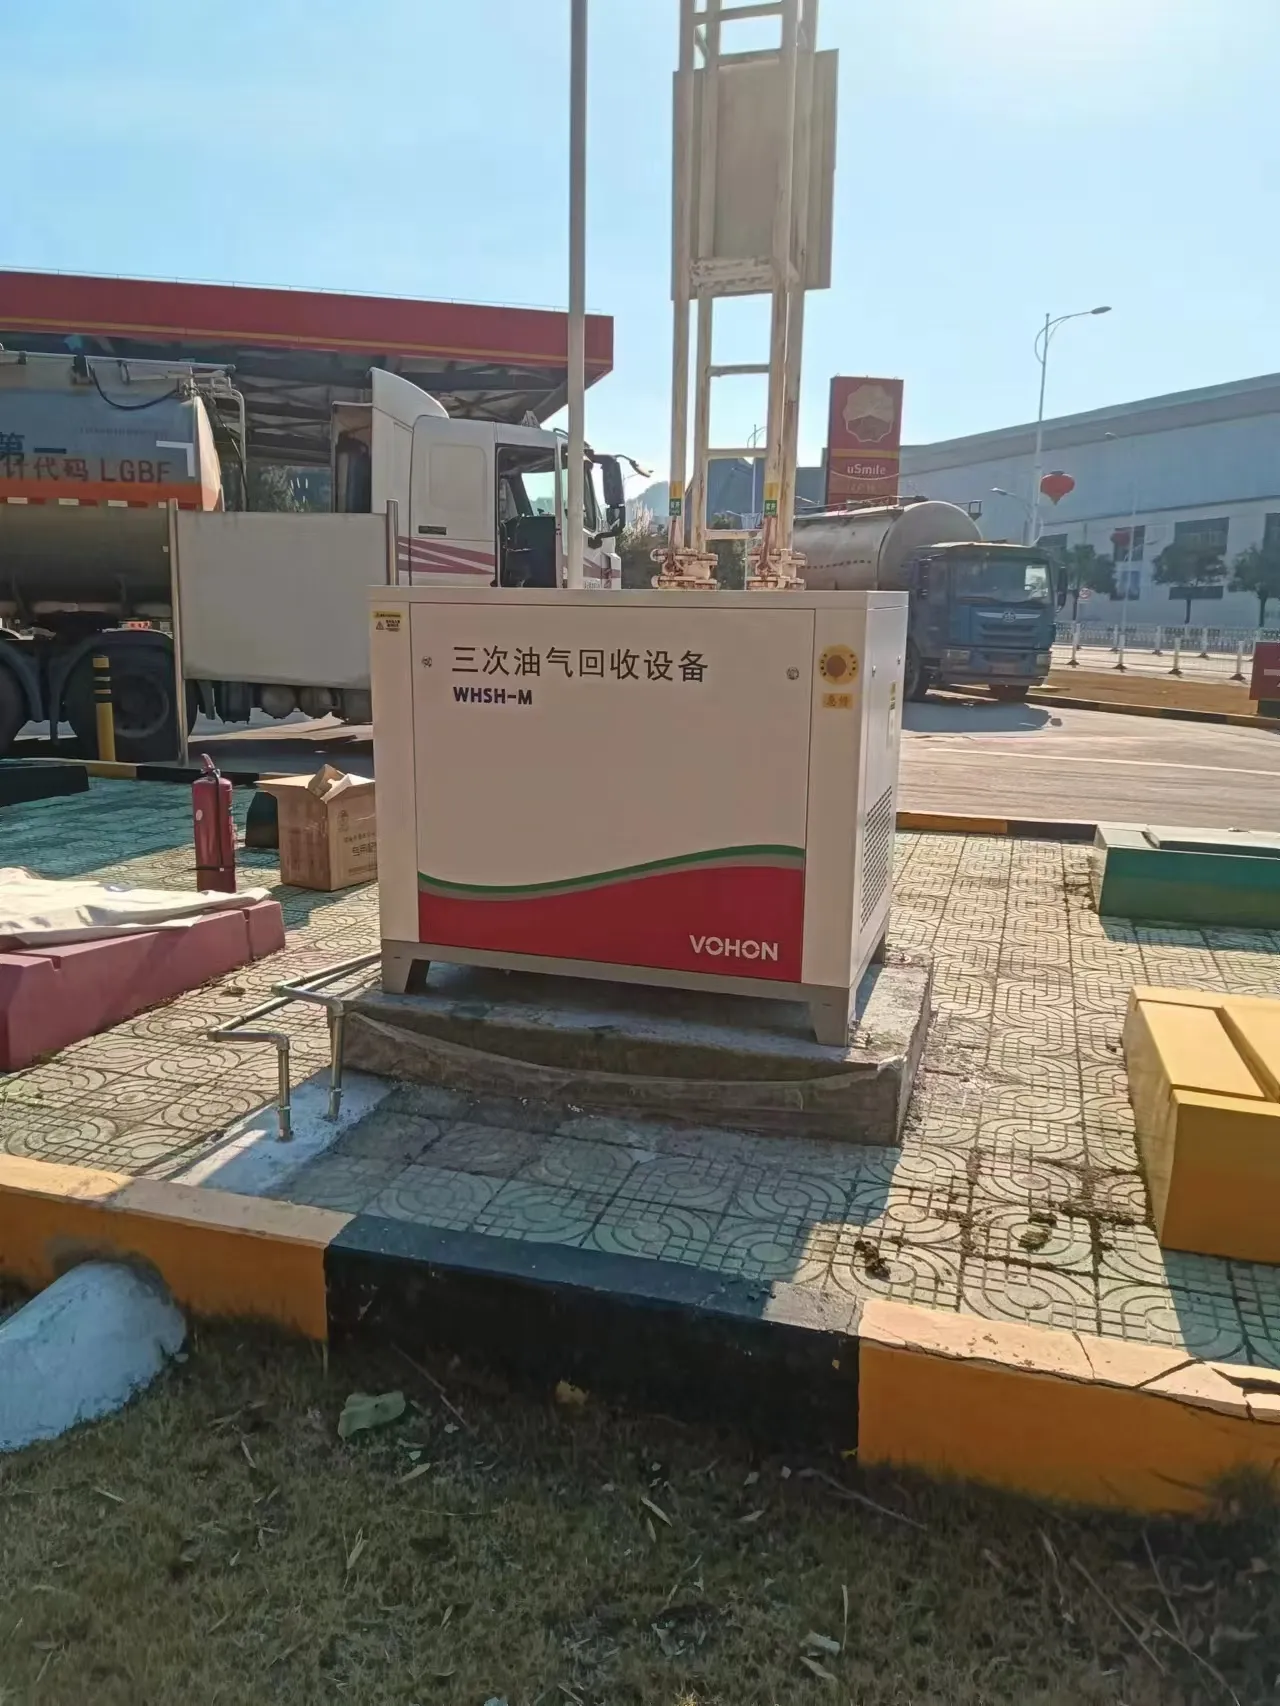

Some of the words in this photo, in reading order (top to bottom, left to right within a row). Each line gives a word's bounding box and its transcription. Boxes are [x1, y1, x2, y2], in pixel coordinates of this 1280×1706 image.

[101, 457, 172, 483] LGBF
[452, 645, 709, 684] 三次油气回收设备
[453, 686, 533, 705] WHSH-M
[689, 934, 779, 962] VOHON
